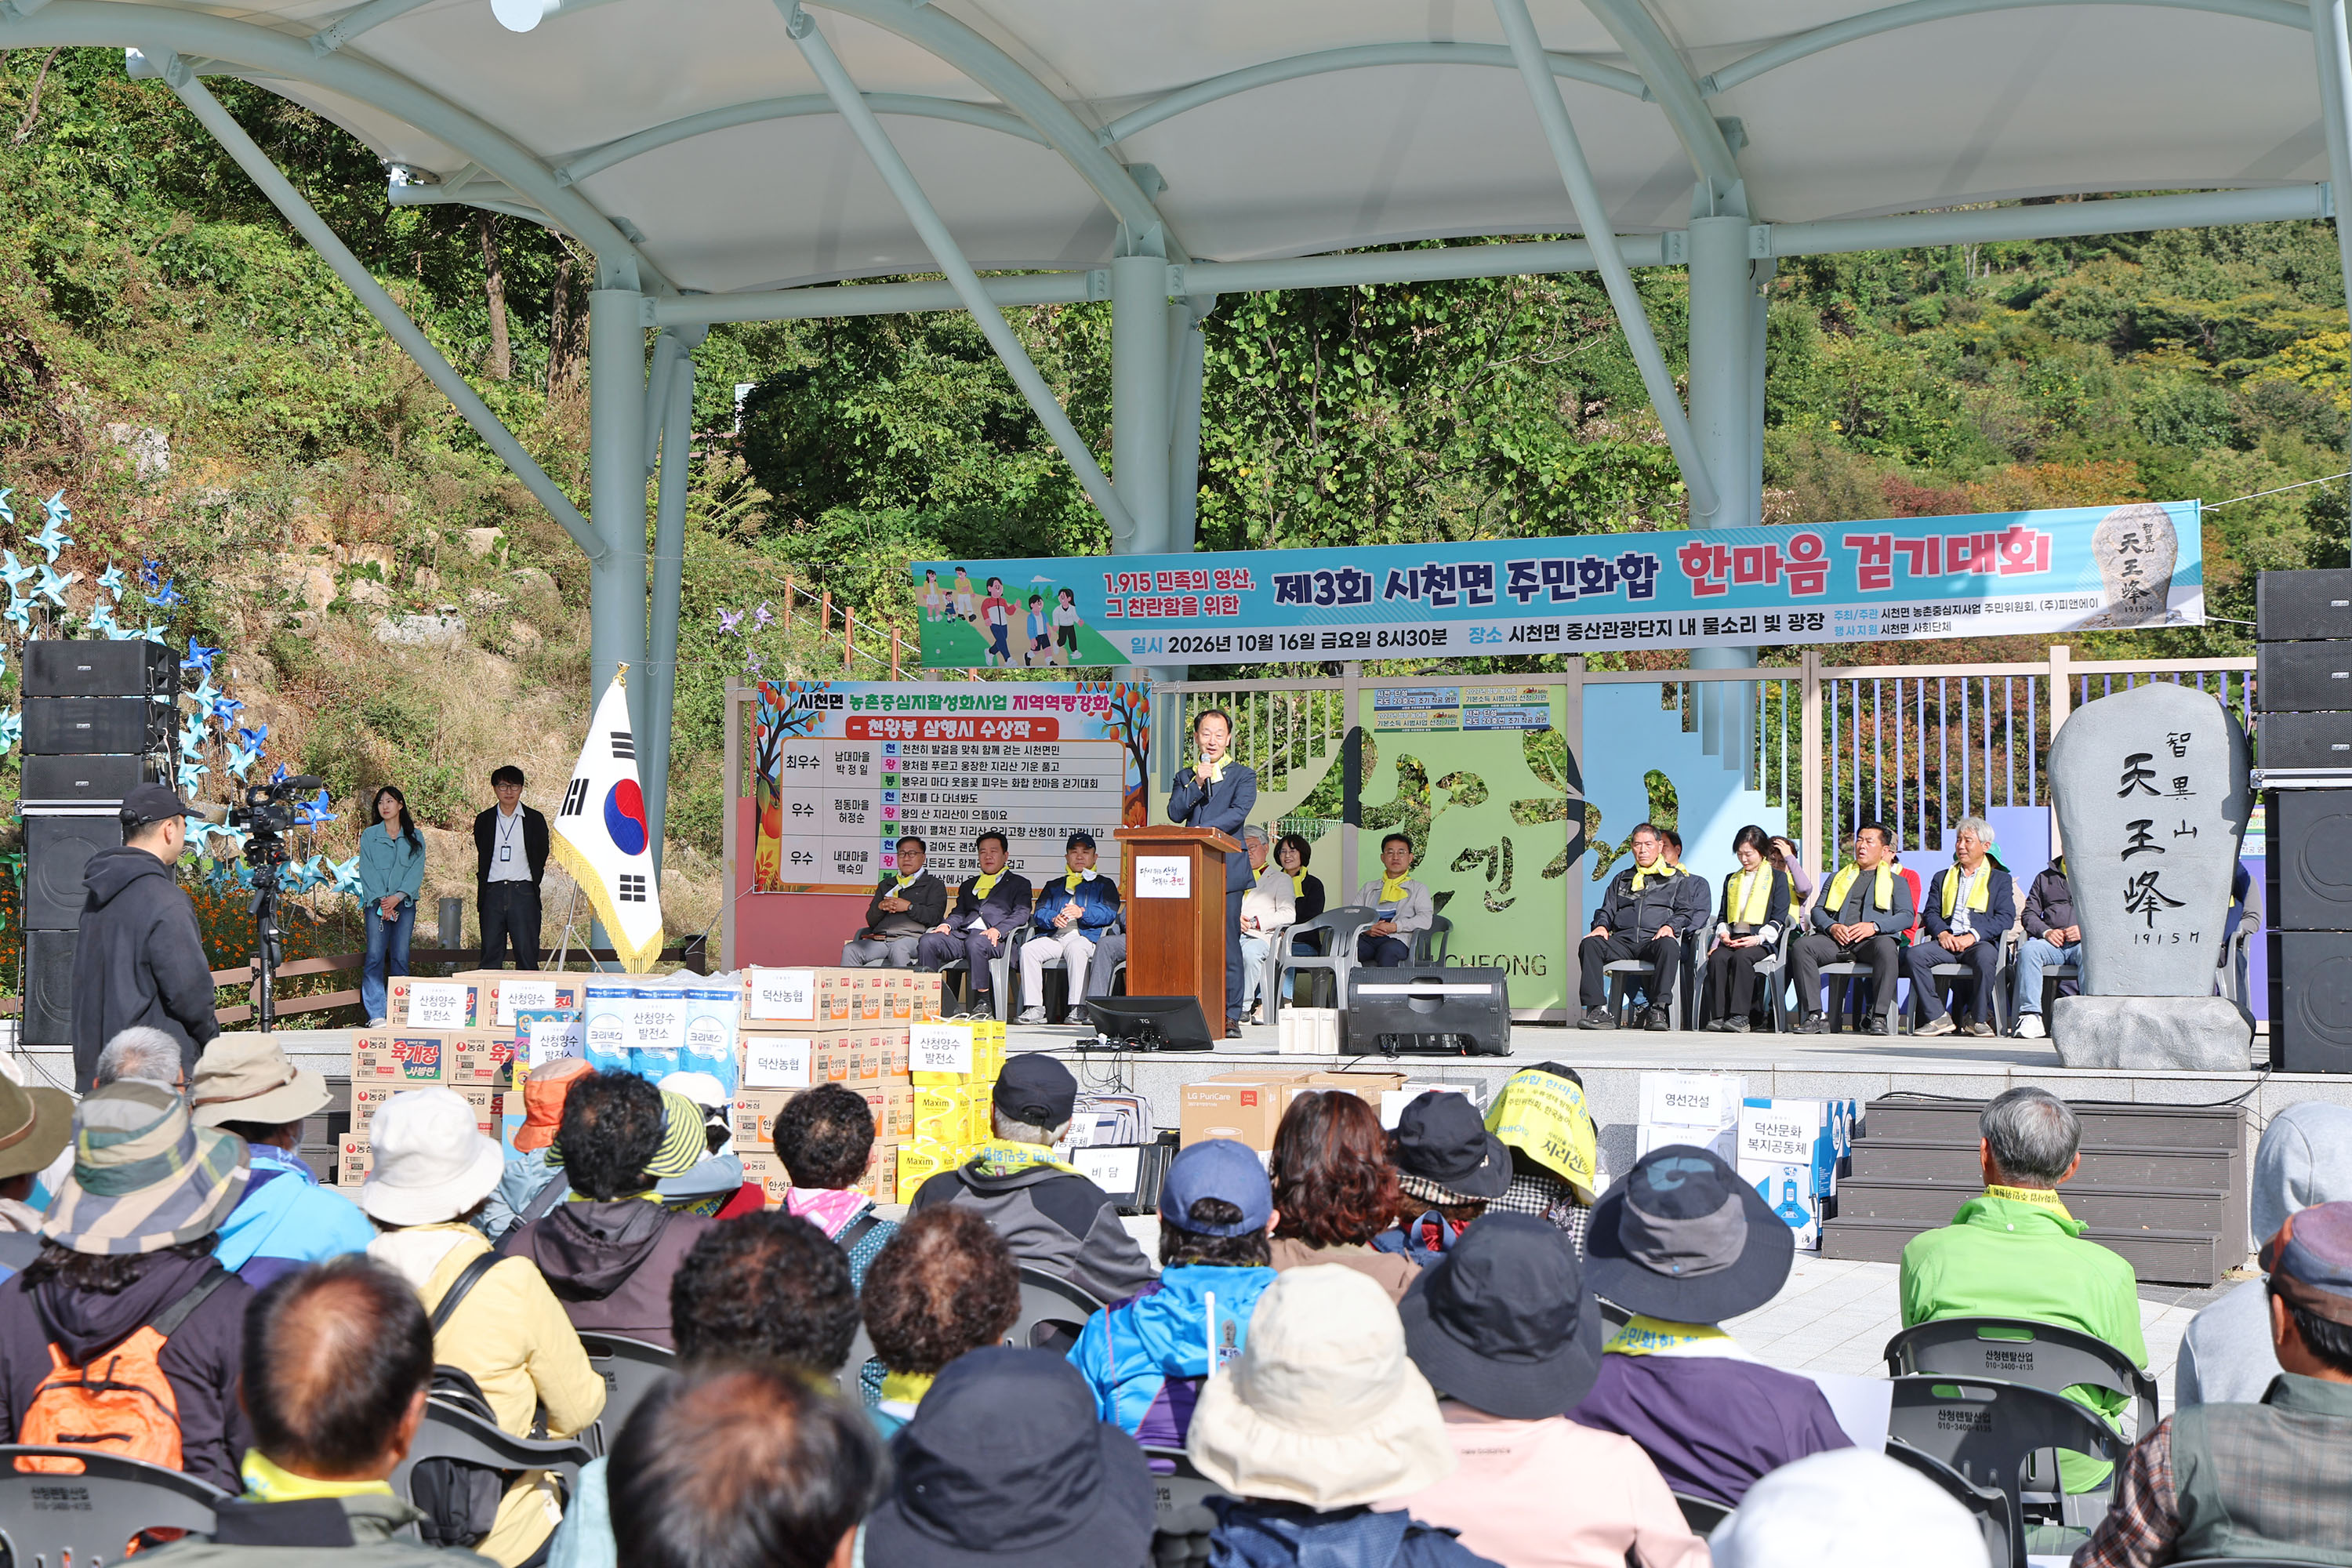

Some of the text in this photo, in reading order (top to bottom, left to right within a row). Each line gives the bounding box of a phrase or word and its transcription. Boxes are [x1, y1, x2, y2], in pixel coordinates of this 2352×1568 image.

[1273, 527, 2050, 606] 제3회 시천면 주민화합 한마음 걷기대회
[1104, 569, 1255, 594] 1,915 민족의 영산,
[1106, 595, 1239, 618] 그 찬란함을 위한
[1834, 597, 2099, 621] 주최/주관 시천면 농촌중심지사업 주민위원회, (주)피앤에이
[2124, 604, 2154, 614] 1915M
[1131, 612, 1825, 654] 일시 2026년 10월 16일 금요일 8시30분 장소 시천면 중산관광단지 내 물소리 빛 광장
[1881, 623, 1910, 635] 시천면
[1912, 621, 1952, 633] 사회단체
[797, 693, 1111, 713] 시천면 농촌중심지활성화사업 지역역량강화
[1482, 717, 1505, 725] 20호선
[867, 718, 1032, 740] 천왕봉 삼행시 수상작
[885, 742, 1060, 756] 천 천천히 발걸음 맞춰 함께 걷는 시천면민
[786, 754, 821, 770] 최우수
[834, 751, 870, 763] 남대마을
[885, 760, 1060, 772] 왕 왕처럼 푸르고 웅장한 지리산 기운 품고
[885, 775, 1099, 789] 봉 봉우리 마다 웃음꽃 피우는 화합 한마음 걷기대회
[884, 791, 979, 804] 천 천지를 다 다녀봐도
[791, 802, 815, 818] 우수
[833, 799, 870, 811] 점동마을
[838, 811, 866, 824] 허정순
[884, 807, 1008, 821] 왕 왕의 산 지리산이 으뜸이요
[884, 824, 895, 835] 봉
[901, 825, 927, 836] 봉황이
[930, 826, 956, 837] 펼쳐진
[960, 826, 986, 837] 지리산
[1029, 826, 1056, 838] 산청이
[884, 840, 956, 852] 천 걸어도
[790, 851, 814, 866] 우수
[833, 850, 869, 862] 내대마을
[884, 855, 895, 867] 왕
[837, 863, 864, 876] 백숙의
[419, 995, 457, 1007] 산청양수
[508, 993, 546, 1005] 산청양수
[763, 989, 803, 1003] 덕산농협
[423, 1009, 451, 1022] 발전소
[633, 1011, 676, 1025] 산청양수
[638, 1026, 670, 1040] 발전소
[689, 1031, 723, 1044] 크리넥스
[368, 1040, 387, 1049] 농심
[466, 1043, 485, 1052] 농심
[540, 1035, 579, 1047] 산청양수
[920, 1036, 961, 1051] 산청양수
[390, 1040, 440, 1065] 육개장
[925, 1052, 956, 1065] 발전소
[758, 1057, 800, 1071] 덕산농협
[406, 1066, 437, 1078] 사발면
[368, 1092, 387, 1102] 농심
[467, 1097, 485, 1105] 농심
[922, 1098, 949, 1107] Maxim
[1200, 1092, 1231, 1101] PuriCare
[1664, 1092, 1710, 1109] 영선건설
[1755, 1121, 1802, 1139] 덕산문화
[1748, 1137, 1808, 1156] 복지공동체
[906, 1157, 934, 1166] Maxim
[1985, 1349, 2034, 1363] 산청렌탈산업
[1985, 1361, 2034, 1371] 010-3400-4135
[1937, 1409, 1992, 1425] 산청렌탈산업
